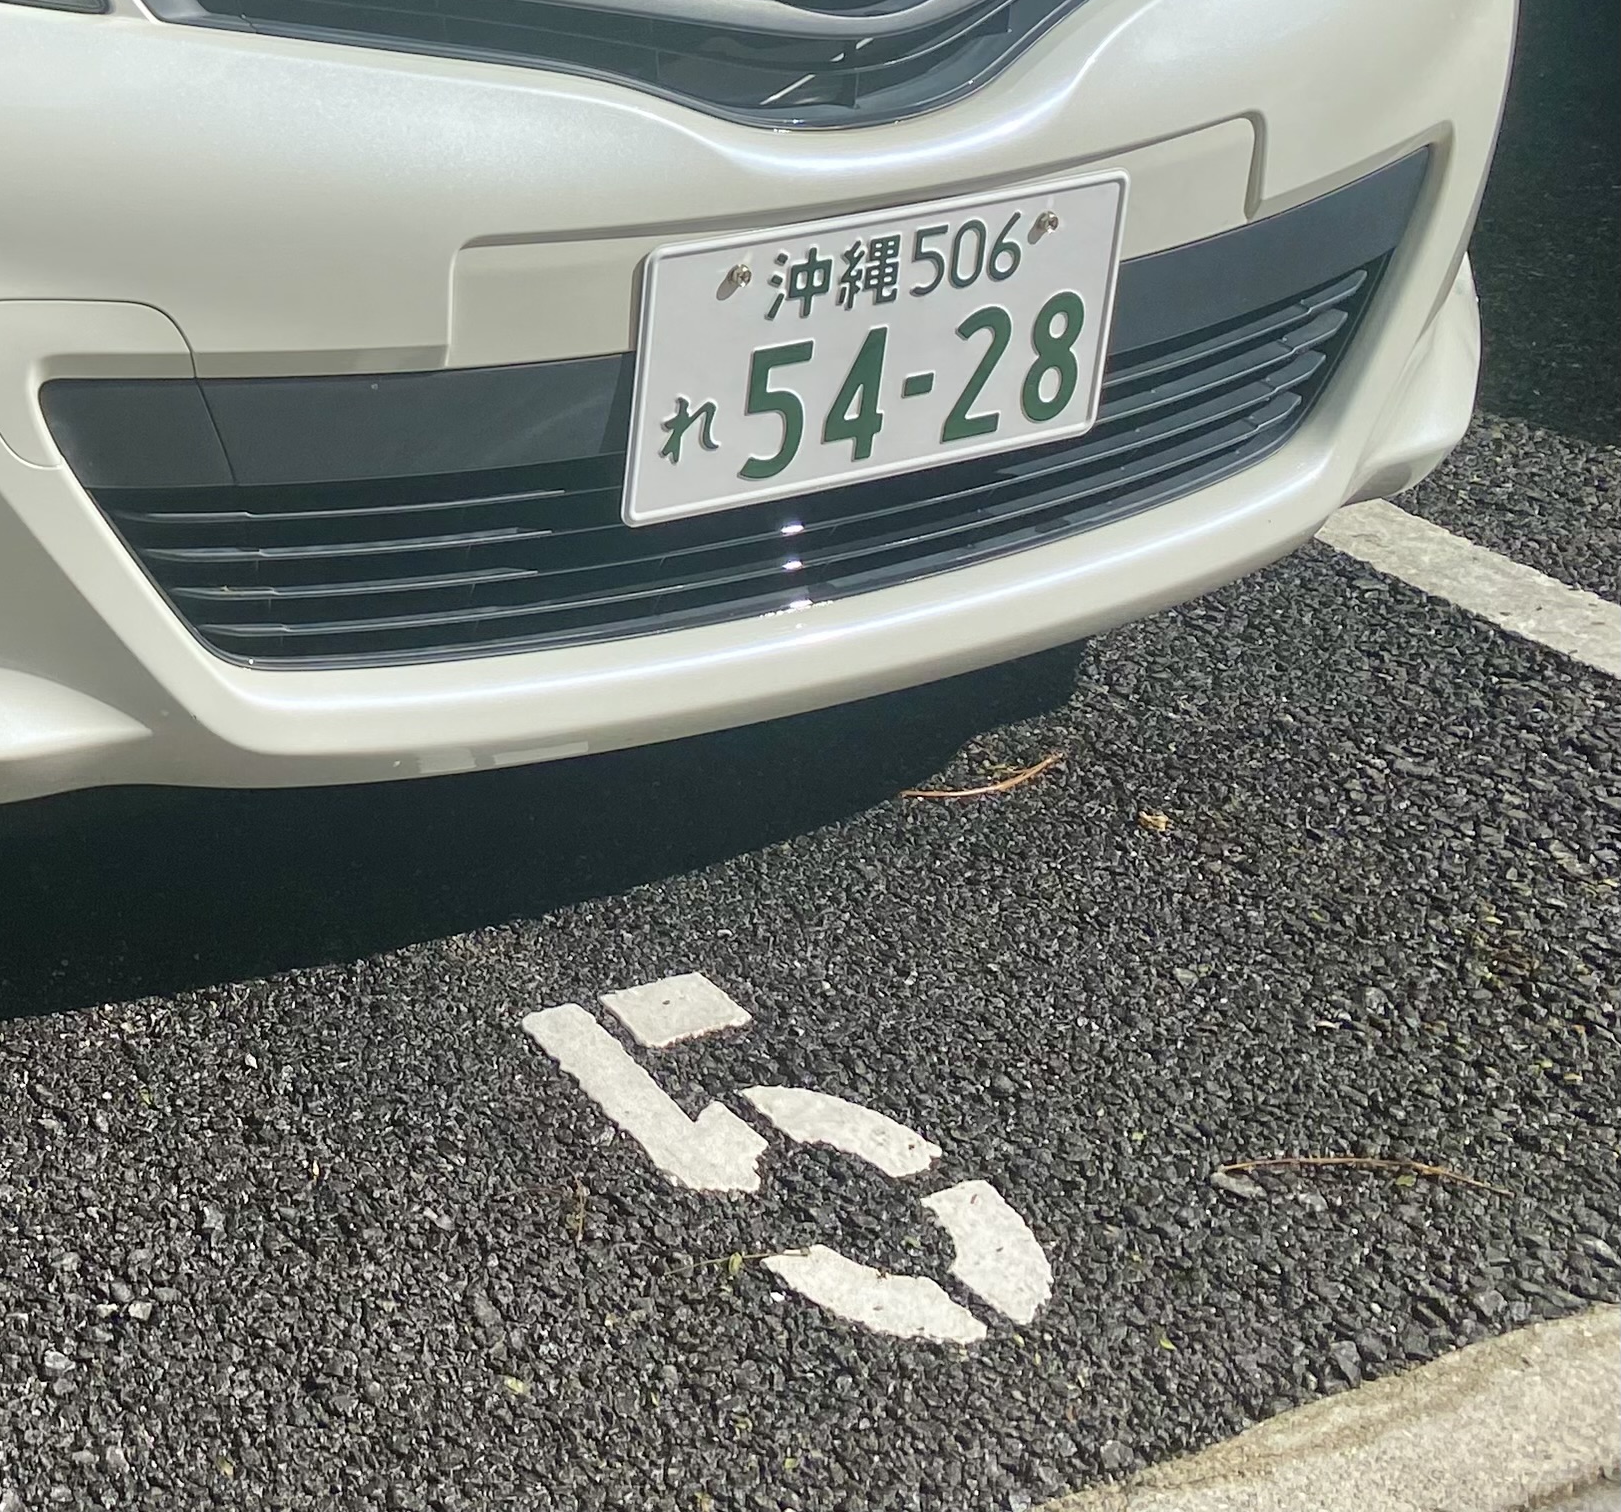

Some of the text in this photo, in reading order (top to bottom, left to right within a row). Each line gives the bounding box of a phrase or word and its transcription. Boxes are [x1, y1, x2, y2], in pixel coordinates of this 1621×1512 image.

[659, 291, 1086, 480] れ 54-28
[522, 972, 1053, 1343] 5
